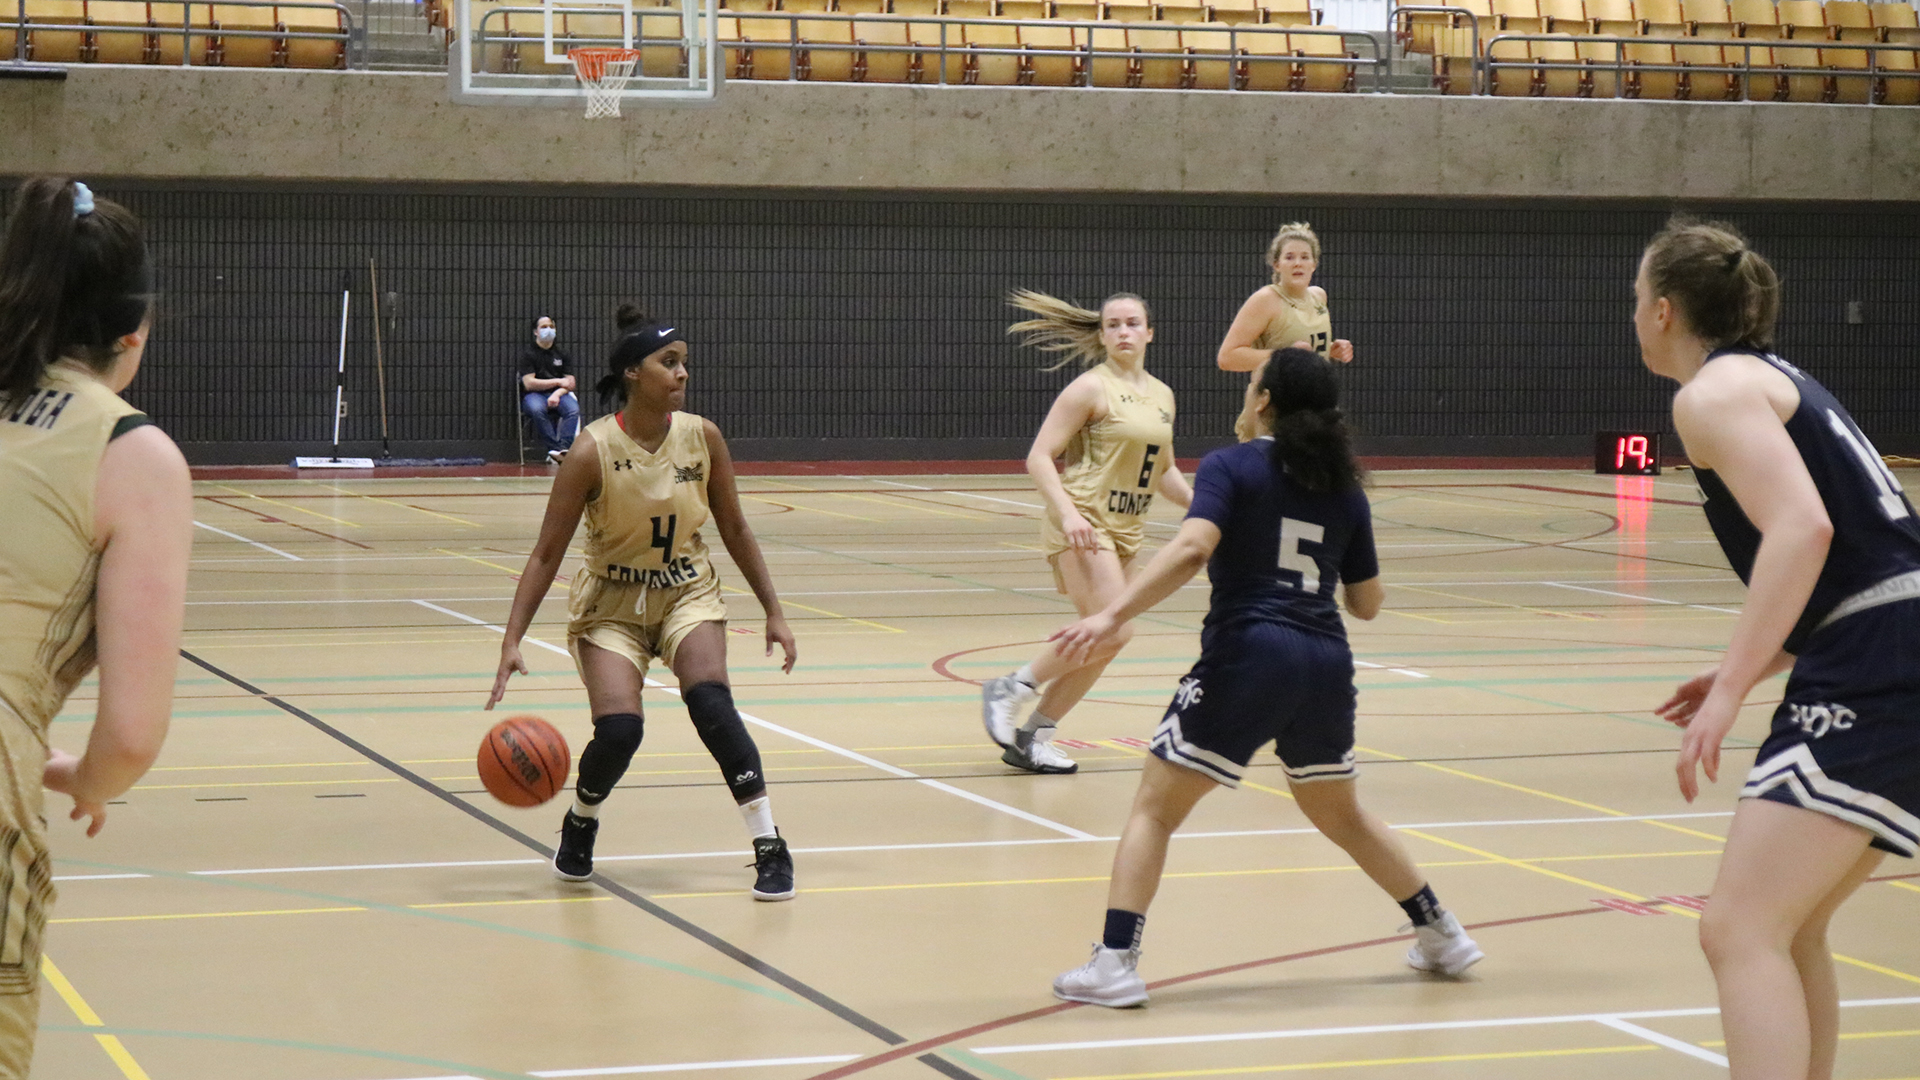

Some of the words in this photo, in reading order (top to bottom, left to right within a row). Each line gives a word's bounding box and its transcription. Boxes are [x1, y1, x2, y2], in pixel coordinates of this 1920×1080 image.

[1138, 444, 1160, 488] 6
[649, 514, 677, 564] 4
[1276, 516, 1325, 595] 5
